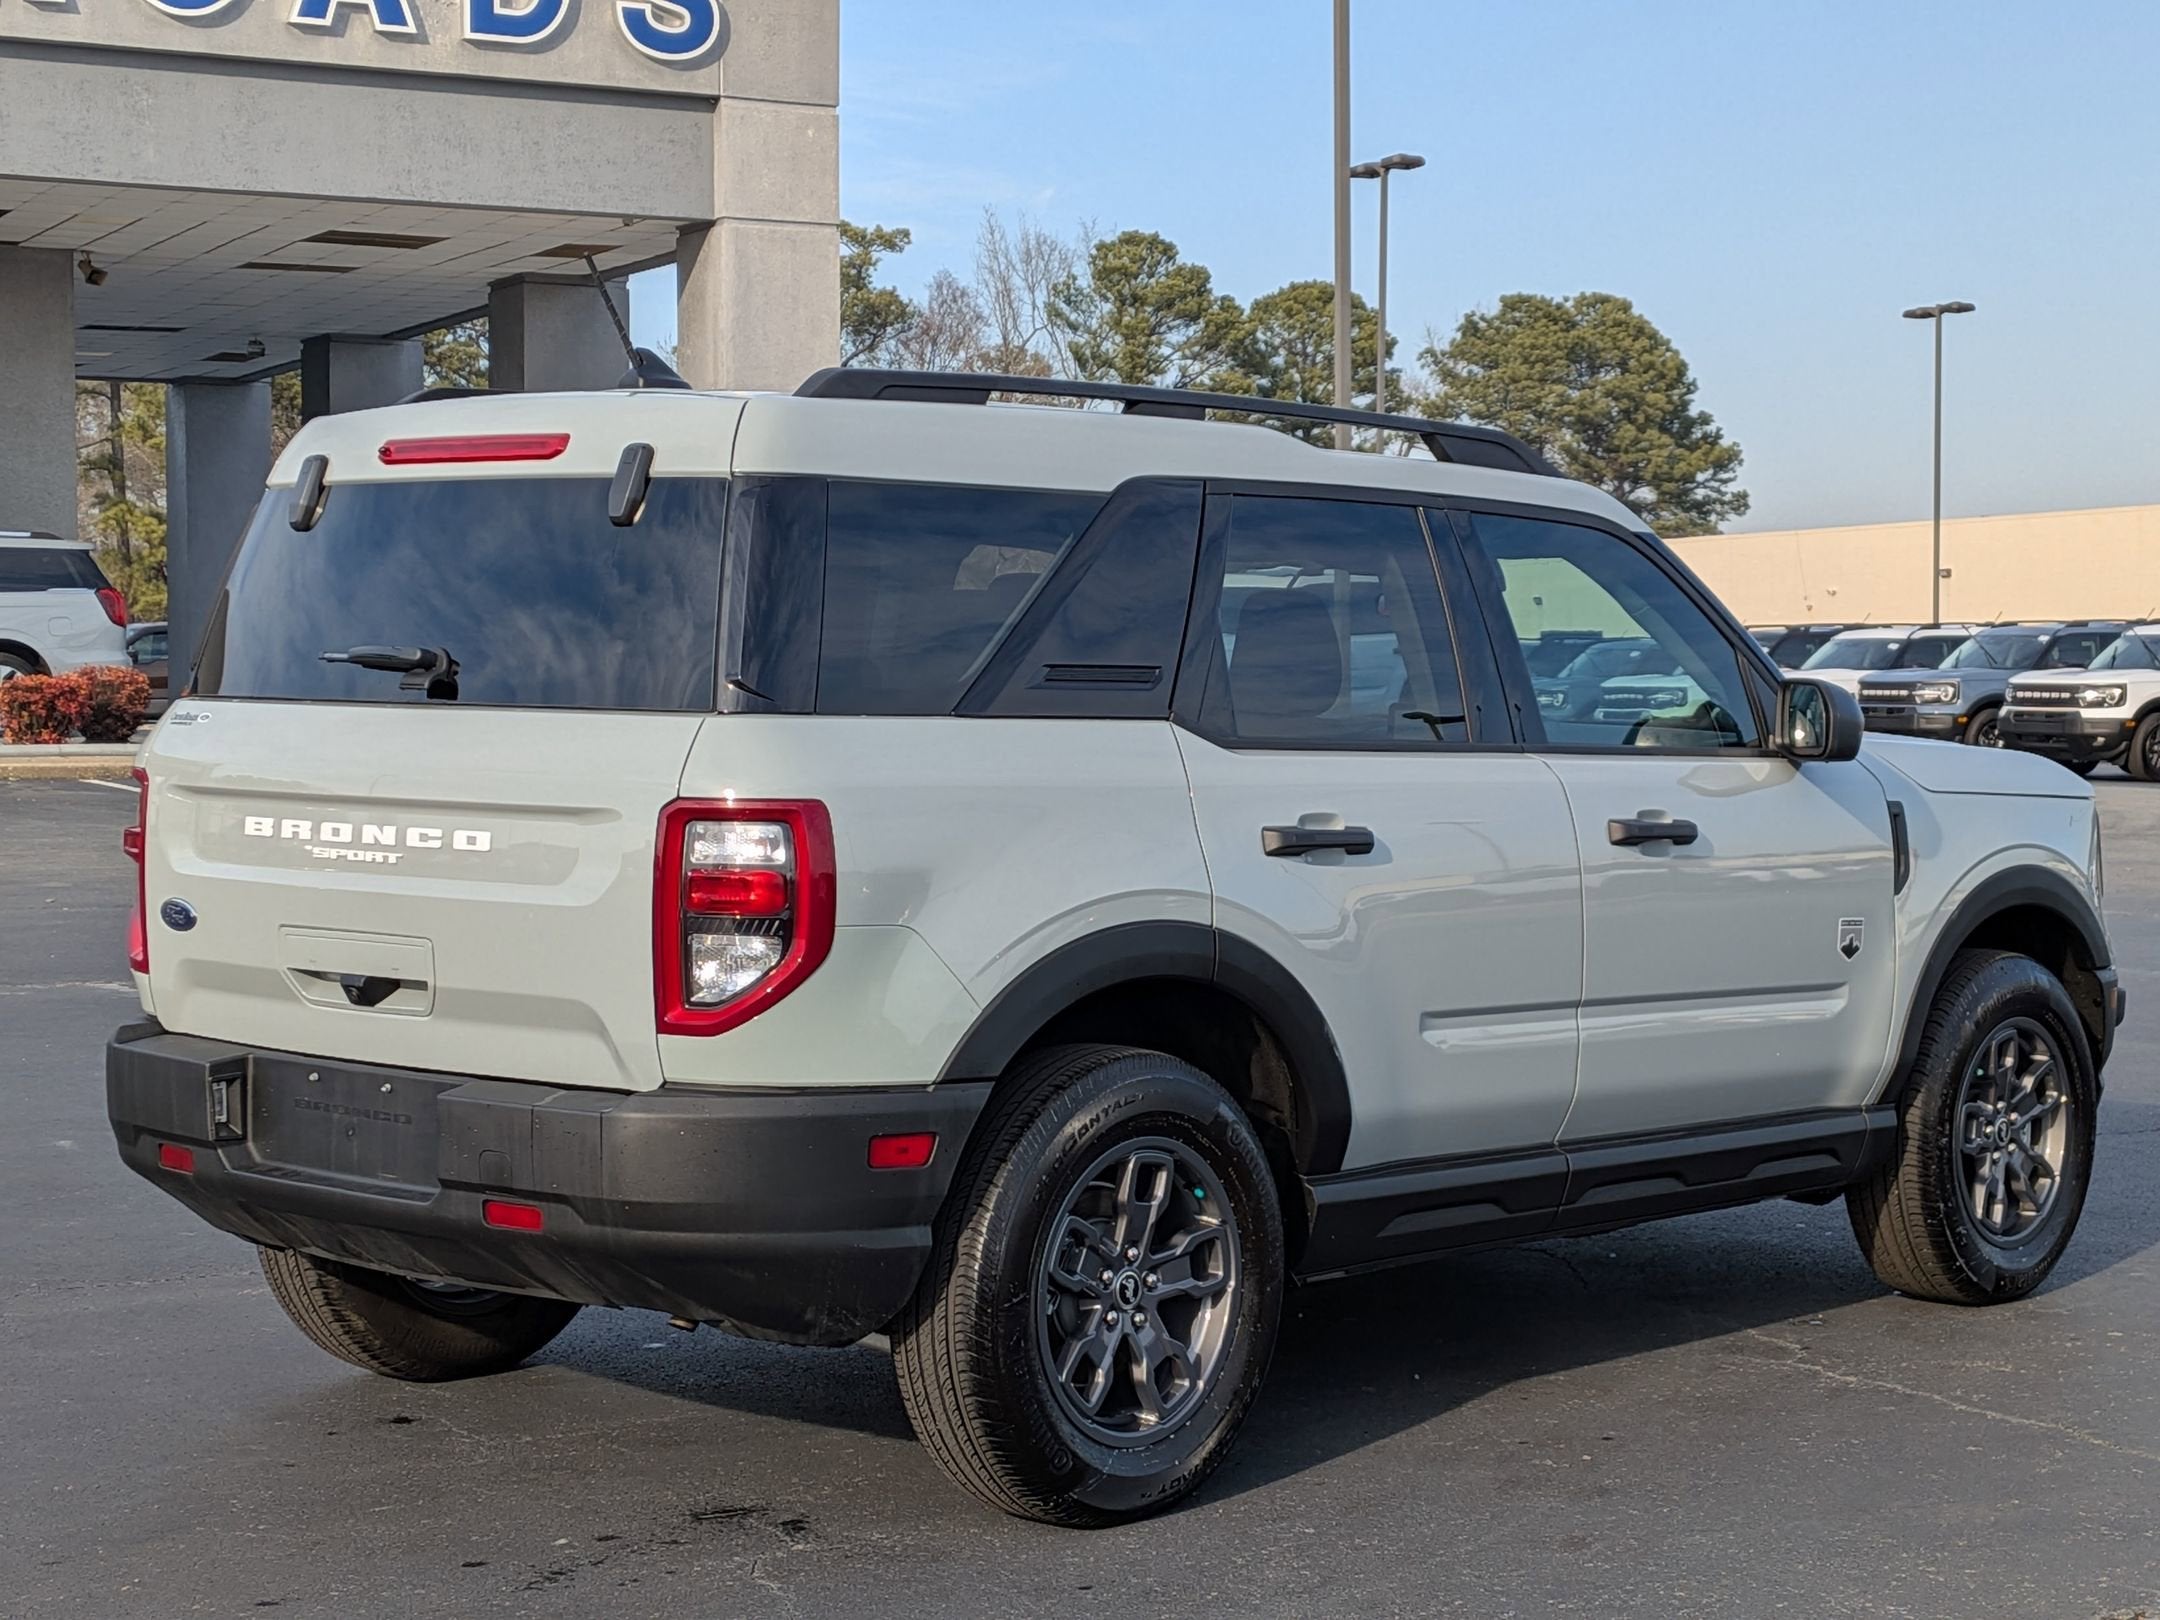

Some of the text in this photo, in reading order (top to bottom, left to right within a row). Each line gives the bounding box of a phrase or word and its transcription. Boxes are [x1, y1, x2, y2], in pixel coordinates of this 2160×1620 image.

[244, 815, 492, 852] BRONCO
[311, 846, 404, 864] SPORT
[294, 1098, 413, 1125] BRONCO
